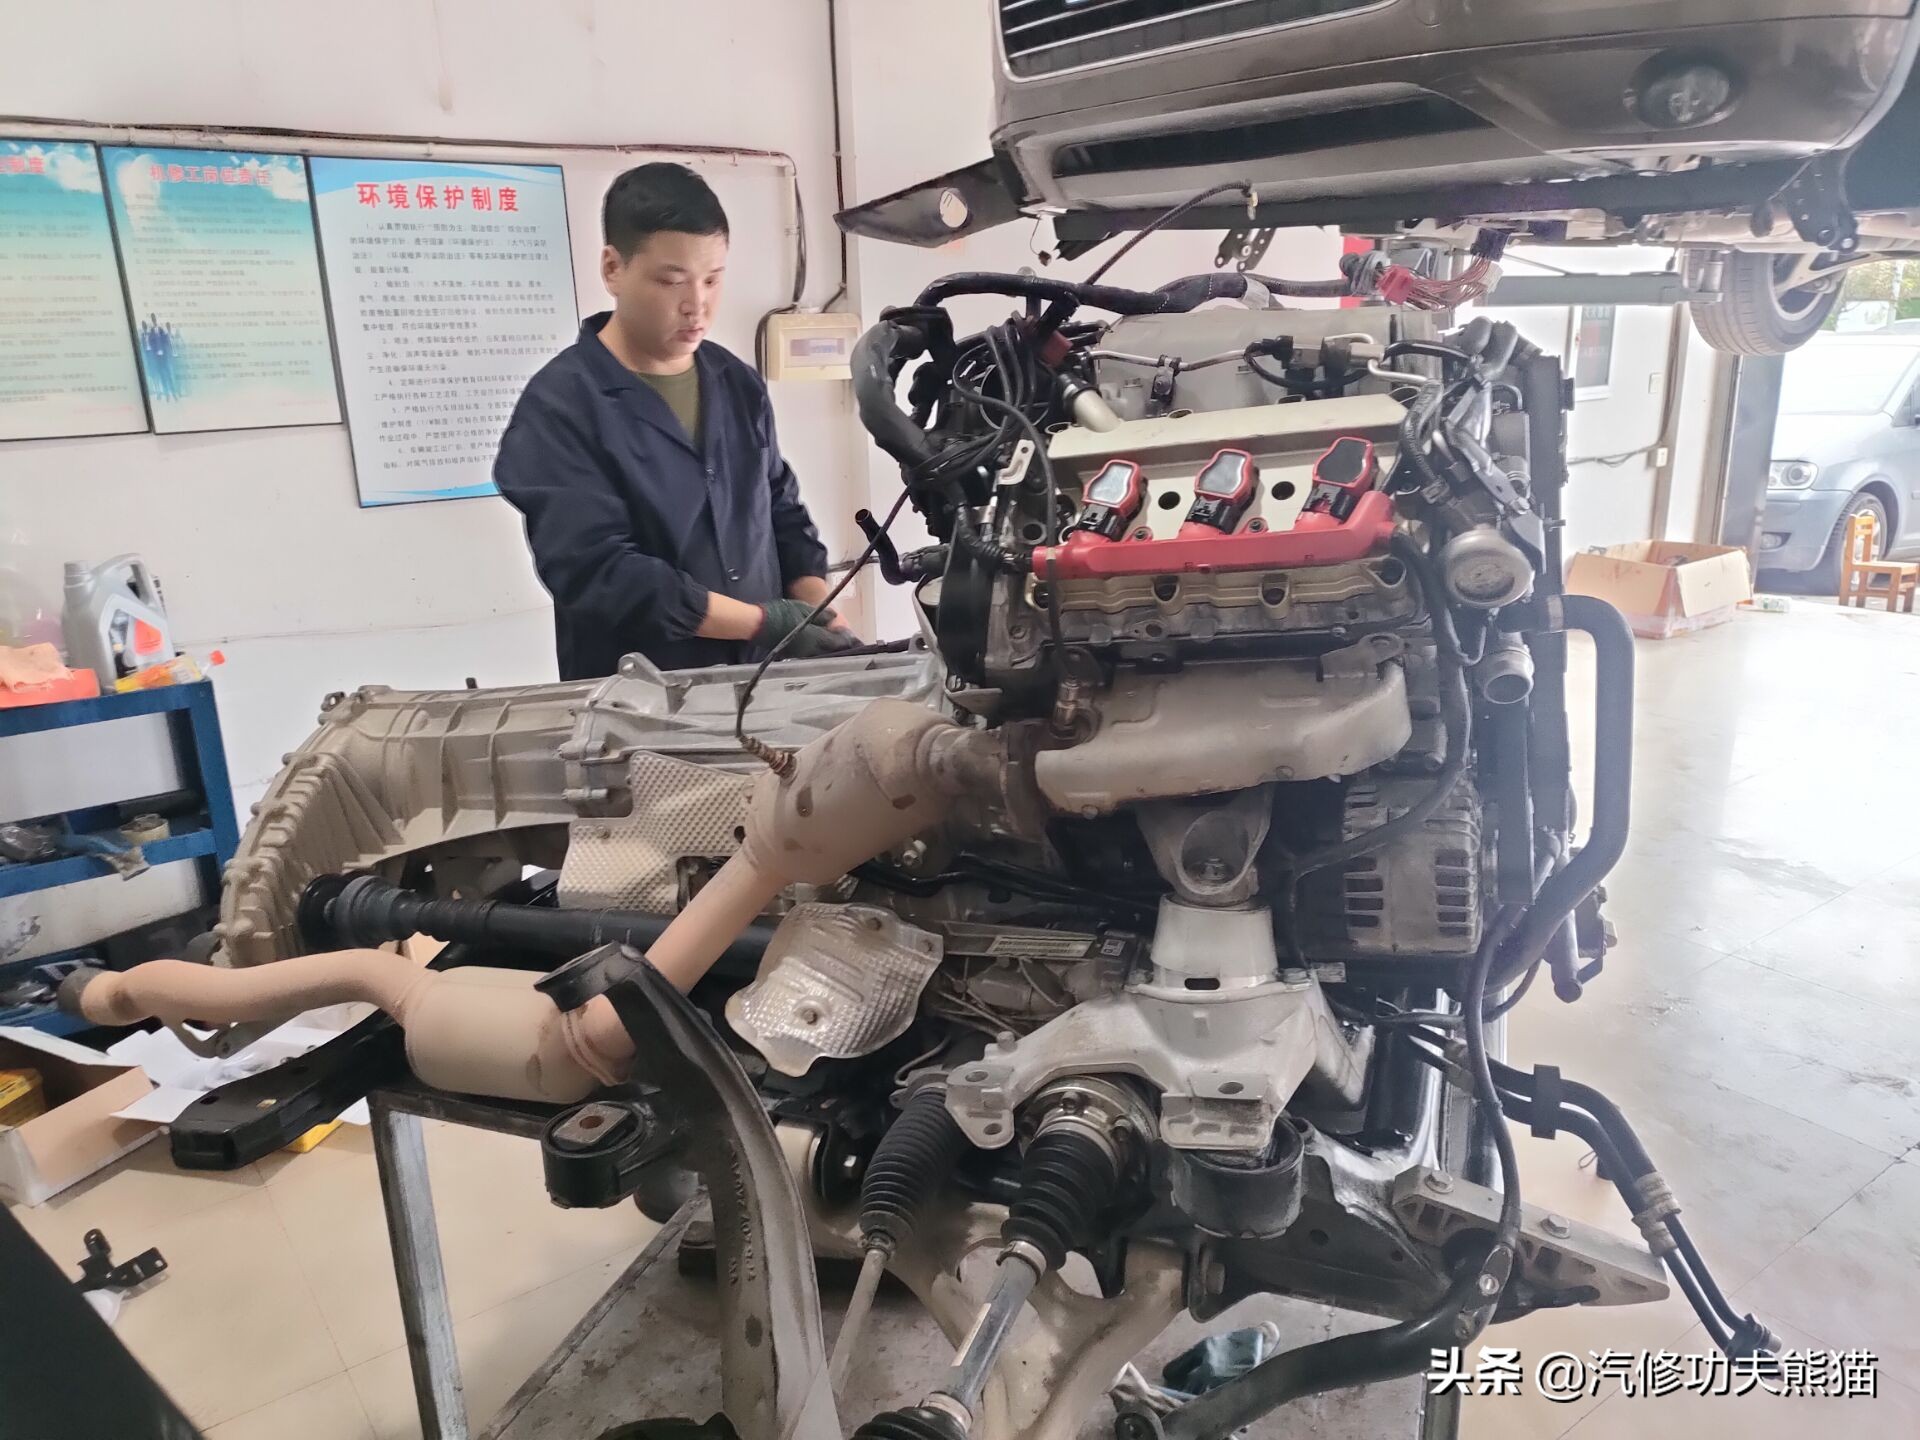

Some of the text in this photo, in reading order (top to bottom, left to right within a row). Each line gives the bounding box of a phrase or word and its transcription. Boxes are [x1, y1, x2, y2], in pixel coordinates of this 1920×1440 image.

[356, 183, 519, 212] 环境保护制度
